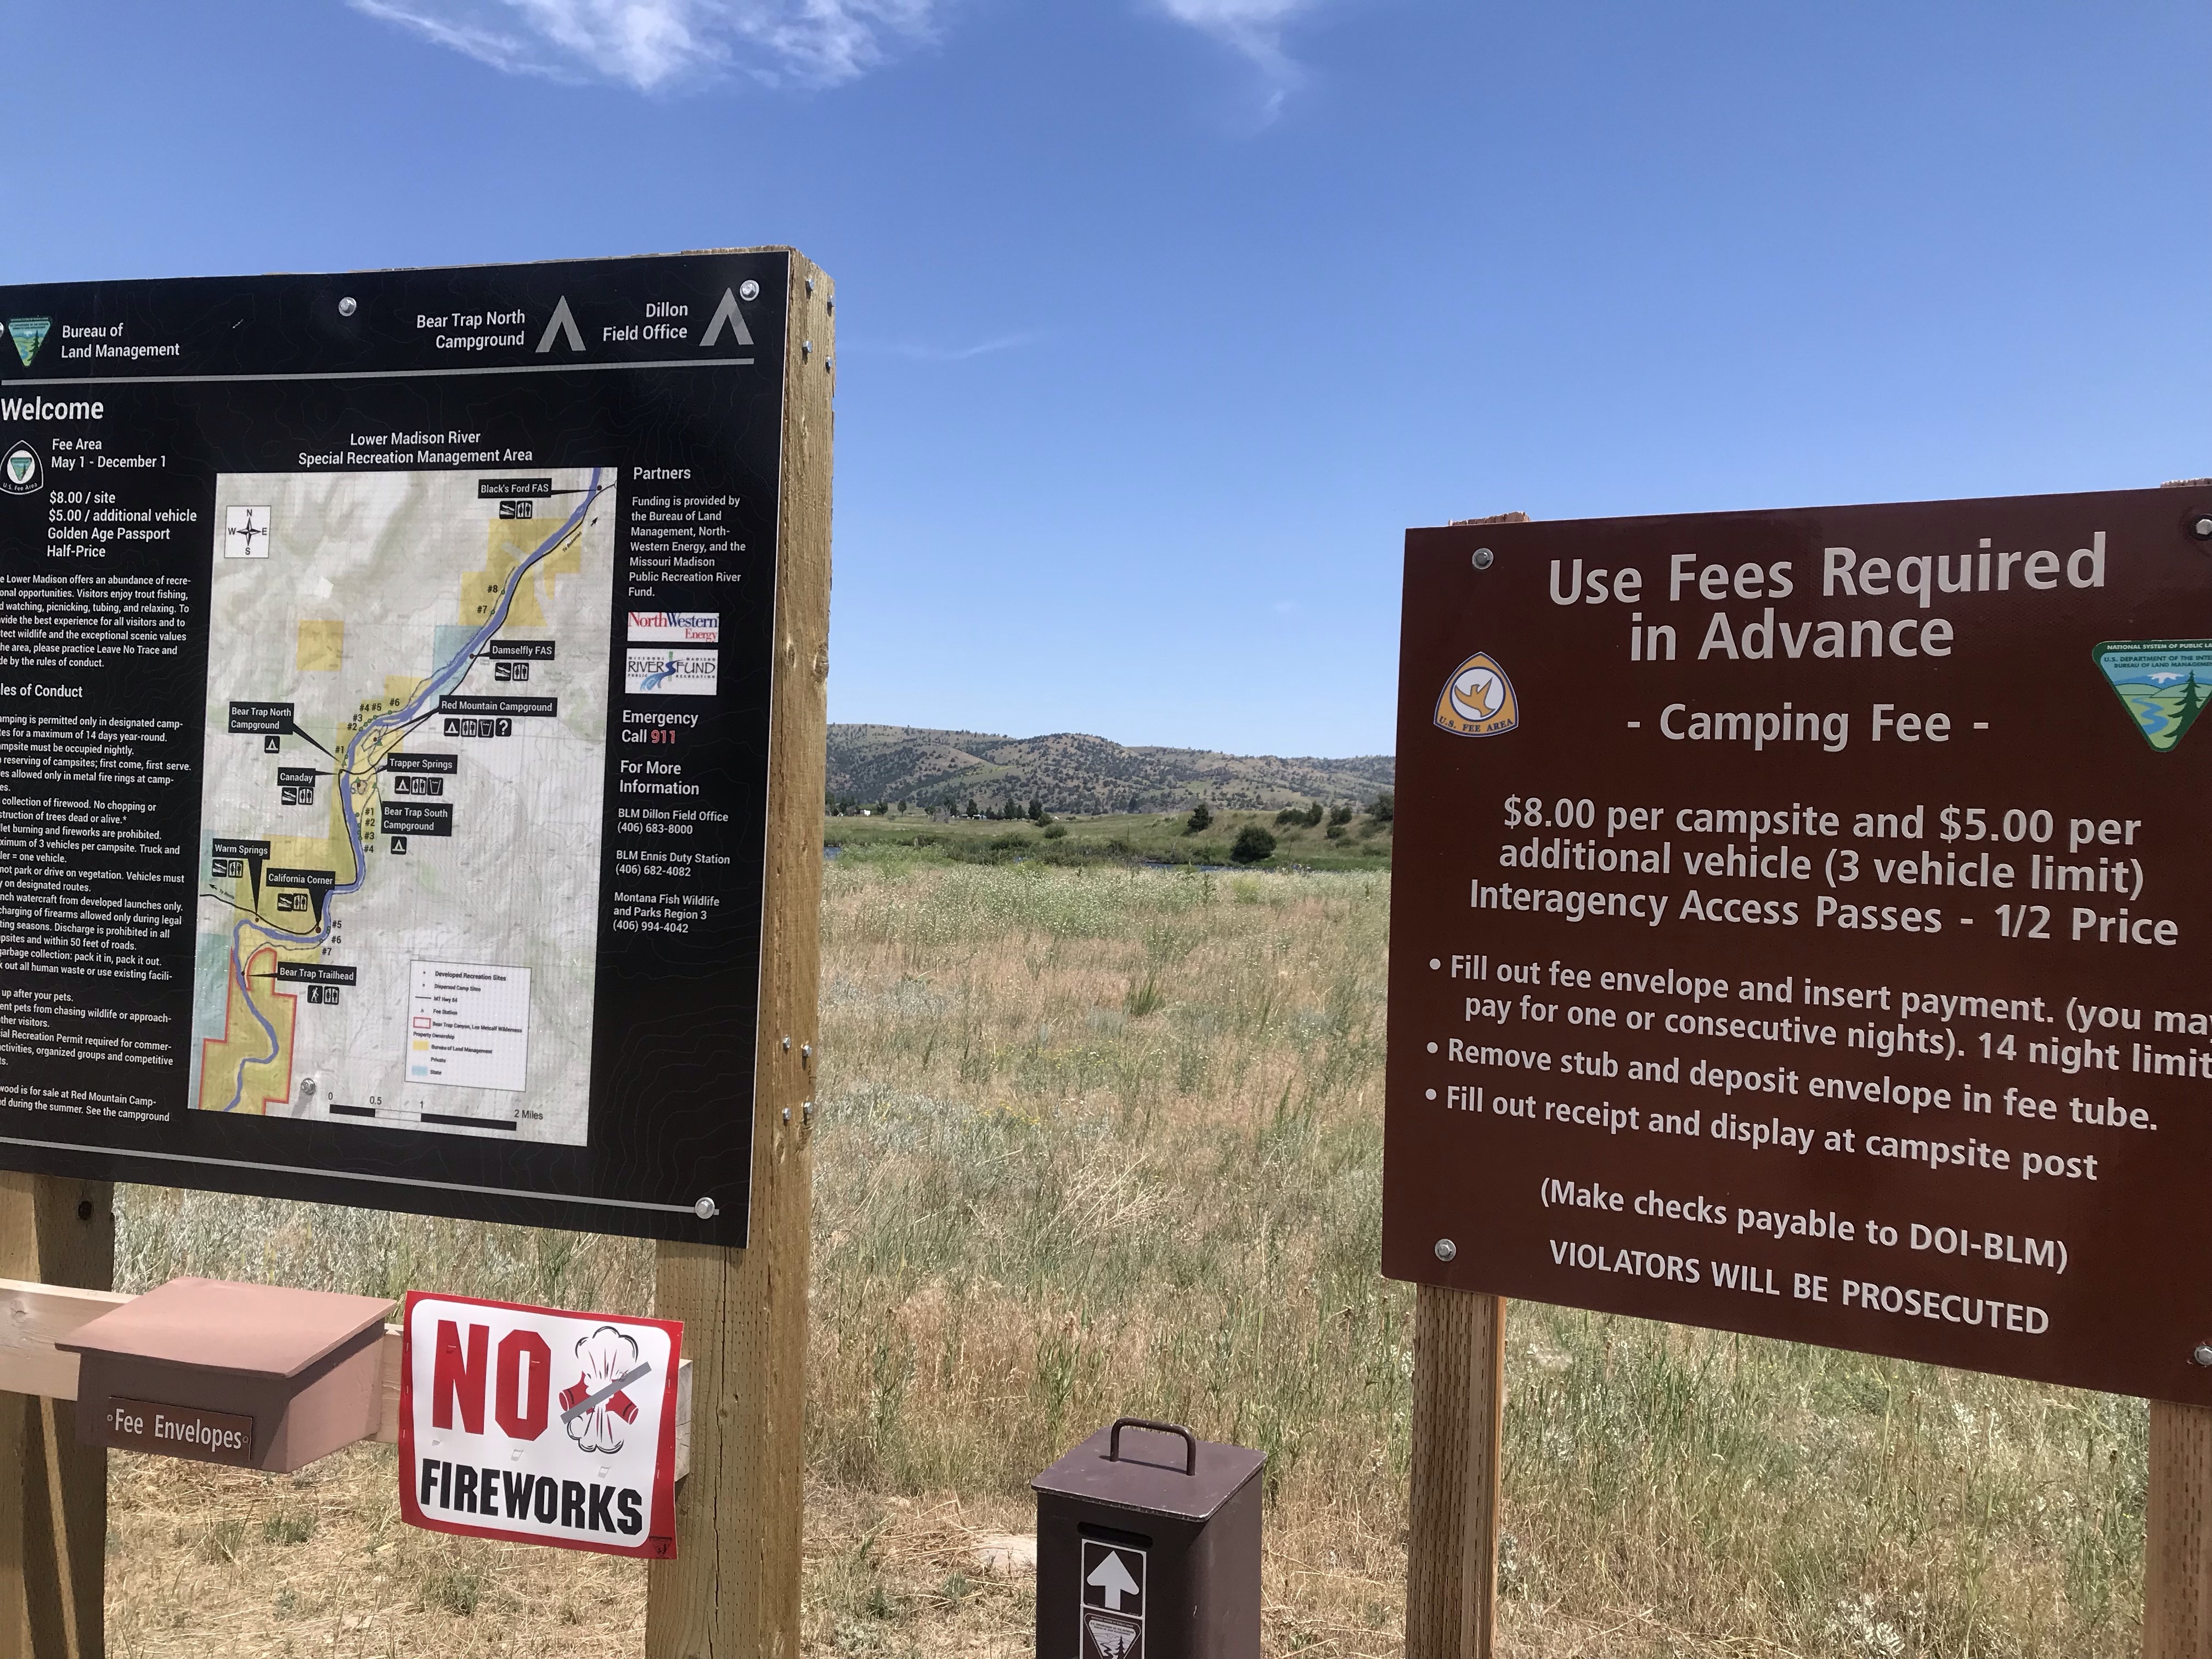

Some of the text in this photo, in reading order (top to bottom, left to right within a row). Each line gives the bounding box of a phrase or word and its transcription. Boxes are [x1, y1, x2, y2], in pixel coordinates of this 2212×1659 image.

[646, 302, 688, 317] Dillon
[417, 309, 525, 329] Bear Trap North
[63, 325, 106, 338] Bureau
[110, 323, 123, 337] of
[603, 324, 687, 341] Field Office
[436, 330, 524, 351] Campground
[61, 343, 180, 360] Land Management
[1, 396, 104, 421] Welcome
[53, 438, 102, 450] Fee Area
[351, 430, 481, 445] Lower Madison River
[52, 456, 76, 471] May
[80, 456, 84, 467] 1
[98, 454, 157, 467] December
[161, 455, 165, 467] 1
[298, 449, 532, 467] Special Recreation Management Area
[634, 467, 691, 479] Partners
[481, 484, 549, 493] Black's Ford FAS
[49, 490, 115, 505] $8.00 / site
[48, 507, 197, 522] $5.00 / additional vehicle
[48, 527, 170, 542] Golden Age Passport
[47, 544, 105, 557] Half-Price
[1550, 531, 2106, 608] Use Fees Required
[685, 628, 718, 642] Energy
[1632, 607, 1953, 661] in Advance
[492, 645, 552, 657] Damselfly FAS
[232, 707, 291, 718] Bear Trap North
[441, 700, 552, 713] Red Mountain Campground
[231, 720, 280, 731] Campground
[623, 710, 698, 727] Emergency
[1439, 715, 1513, 732] U.S. FEE AREA
[1660, 702, 1849, 752] Camping
[1872, 703, 1951, 742] Fee
[622, 729, 675, 744] Call 911
[390, 758, 452, 770] Trapper Springs
[280, 772, 313, 783] Canaday
[2, 796, 41, 806] collection
[43, 798, 52, 807] of
[53, 798, 91, 809] firewood.
[93, 800, 105, 809] No
[107, 800, 145, 813] chopping
[618, 808, 729, 822] BLM Dillon Field Office
[1504, 793, 2142, 853] $8.00 per campsite and $5.00 per
[618, 821, 693, 834] (406) 683-8000
[1500, 837, 2143, 901] additional vehicle (3 vehicle limit)
[1471, 879, 1669, 926] Interagency
[1679, 890, 1798, 925] Access
[1817, 895, 1942, 933] Passes
[1995, 904, 2050, 939] 1/2
[2073, 907, 2178, 946] Price
[2, 989, 74, 1002] up after your pets.
[1452, 955, 2212, 1043] Fill out fee envelope and insert payment. (you ma
[1466, 997, 1512, 1025] pay
[1520, 995, 1558, 1022] for
[1568, 1006, 1616, 1027] one
[1626, 1011, 1655, 1030] or
[1664, 1014, 1837, 1046] consecutive
[1848, 1022, 1964, 1061] nights).
[1978, 1032, 2017, 1061] 14
[2030, 1037, 2120, 1074] night
[1448, 1038, 2157, 1130] Remove stub and deposit envelope in fee tube.
[1447, 1085, 2098, 1181] Fill out receipt and display at campsite post
[1542, 1177, 2067, 1274] (Make checks payable to DOI-BLM)
[1549, 1240, 2049, 1334] VIOLATORS WILL BE PROSECUTED
[433, 1320, 550, 1440] NO
[115, 1408, 241, 1452] Fee Envelopes
[421, 1459, 642, 1535] FIREWORKS
